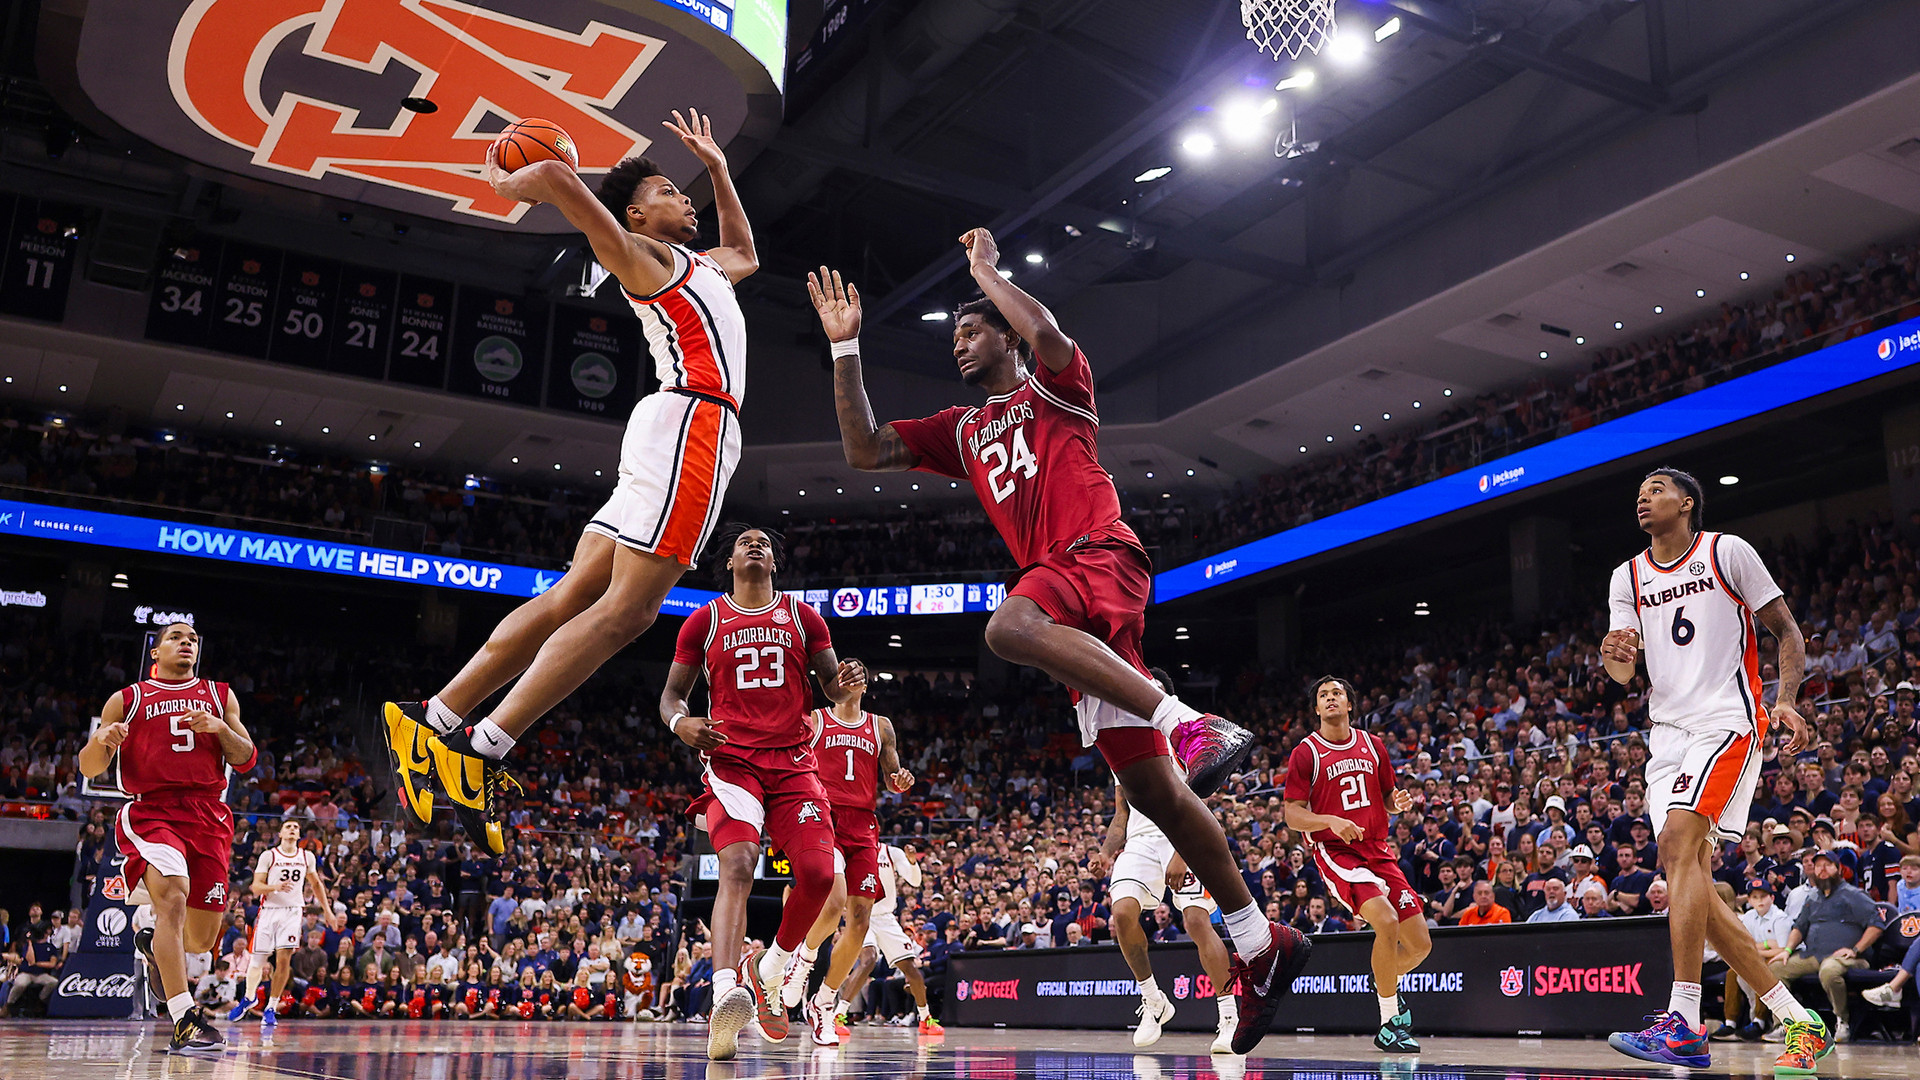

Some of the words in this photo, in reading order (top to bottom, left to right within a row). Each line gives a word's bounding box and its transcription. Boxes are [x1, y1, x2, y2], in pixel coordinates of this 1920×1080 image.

[822, 5, 848, 44] 1988
[20, 240, 66, 258] PERSON
[26, 258, 55, 289] 11
[161, 269, 213, 286] JACKSON
[160, 285, 203, 316] 34
[227, 281, 268, 298] BOLTON
[295, 294, 318, 308] ORR
[223, 297, 264, 327] 25
[282, 308, 324, 339] 50
[349, 305, 380, 320] JONES
[401, 315, 444, 332] BONNER
[481, 313, 524, 328] WOMEN'S
[345, 320, 377, 350] 21
[476, 320, 526, 337] BASKETBALL
[400, 330, 440, 361] 24
[572, 338, 620, 353] BASKETBALL
[980, 424, 1039, 504] 24
[1492, 467, 1525, 486] jackson
[33, 519, 70, 531] MEMBER
[157, 526, 236, 556] HOW
[239, 536, 302, 564] MAY
[306, 544, 355, 572] WE
[358, 551, 430, 580] HELP
[432, 560, 502, 589] YOU?
[3, 590, 46, 605] pretzels
[866, 588, 888, 615] 45
[923, 586, 955, 599] 1:30
[1639, 576, 1716, 608] AUBURN
[930, 601, 944, 612] 26
[1671, 605, 1695, 647] 6
[722, 627, 793, 652] RAZORBACKS
[734, 646, 785, 690] 23
[145, 698, 212, 720] RAZORBACKS
[169, 715, 195, 752] 5
[825, 734, 875, 756] RAZORBACKS
[844, 748, 855, 781] 1
[1326, 758, 1374, 781] RAZORBACKS
[1339, 773, 1371, 812] 21
[279, 869, 301, 882] 38
[772, 859, 790, 875] 45
[58, 972, 136, 998] Coca-Cola
[971, 979, 1020, 1001] SEATGEEK
[1036, 981, 1068, 997] OFFICIAL
[1068, 980, 1095, 996] TICKET
[1094, 979, 1142, 997] MARKETPLA
[1291, 974, 1338, 995] OFFICIAL
[1338, 973, 1375, 993] TICKE
[1397, 972, 1464, 993] KETPLACE
[1534, 962, 1644, 997] SEATGEEK
